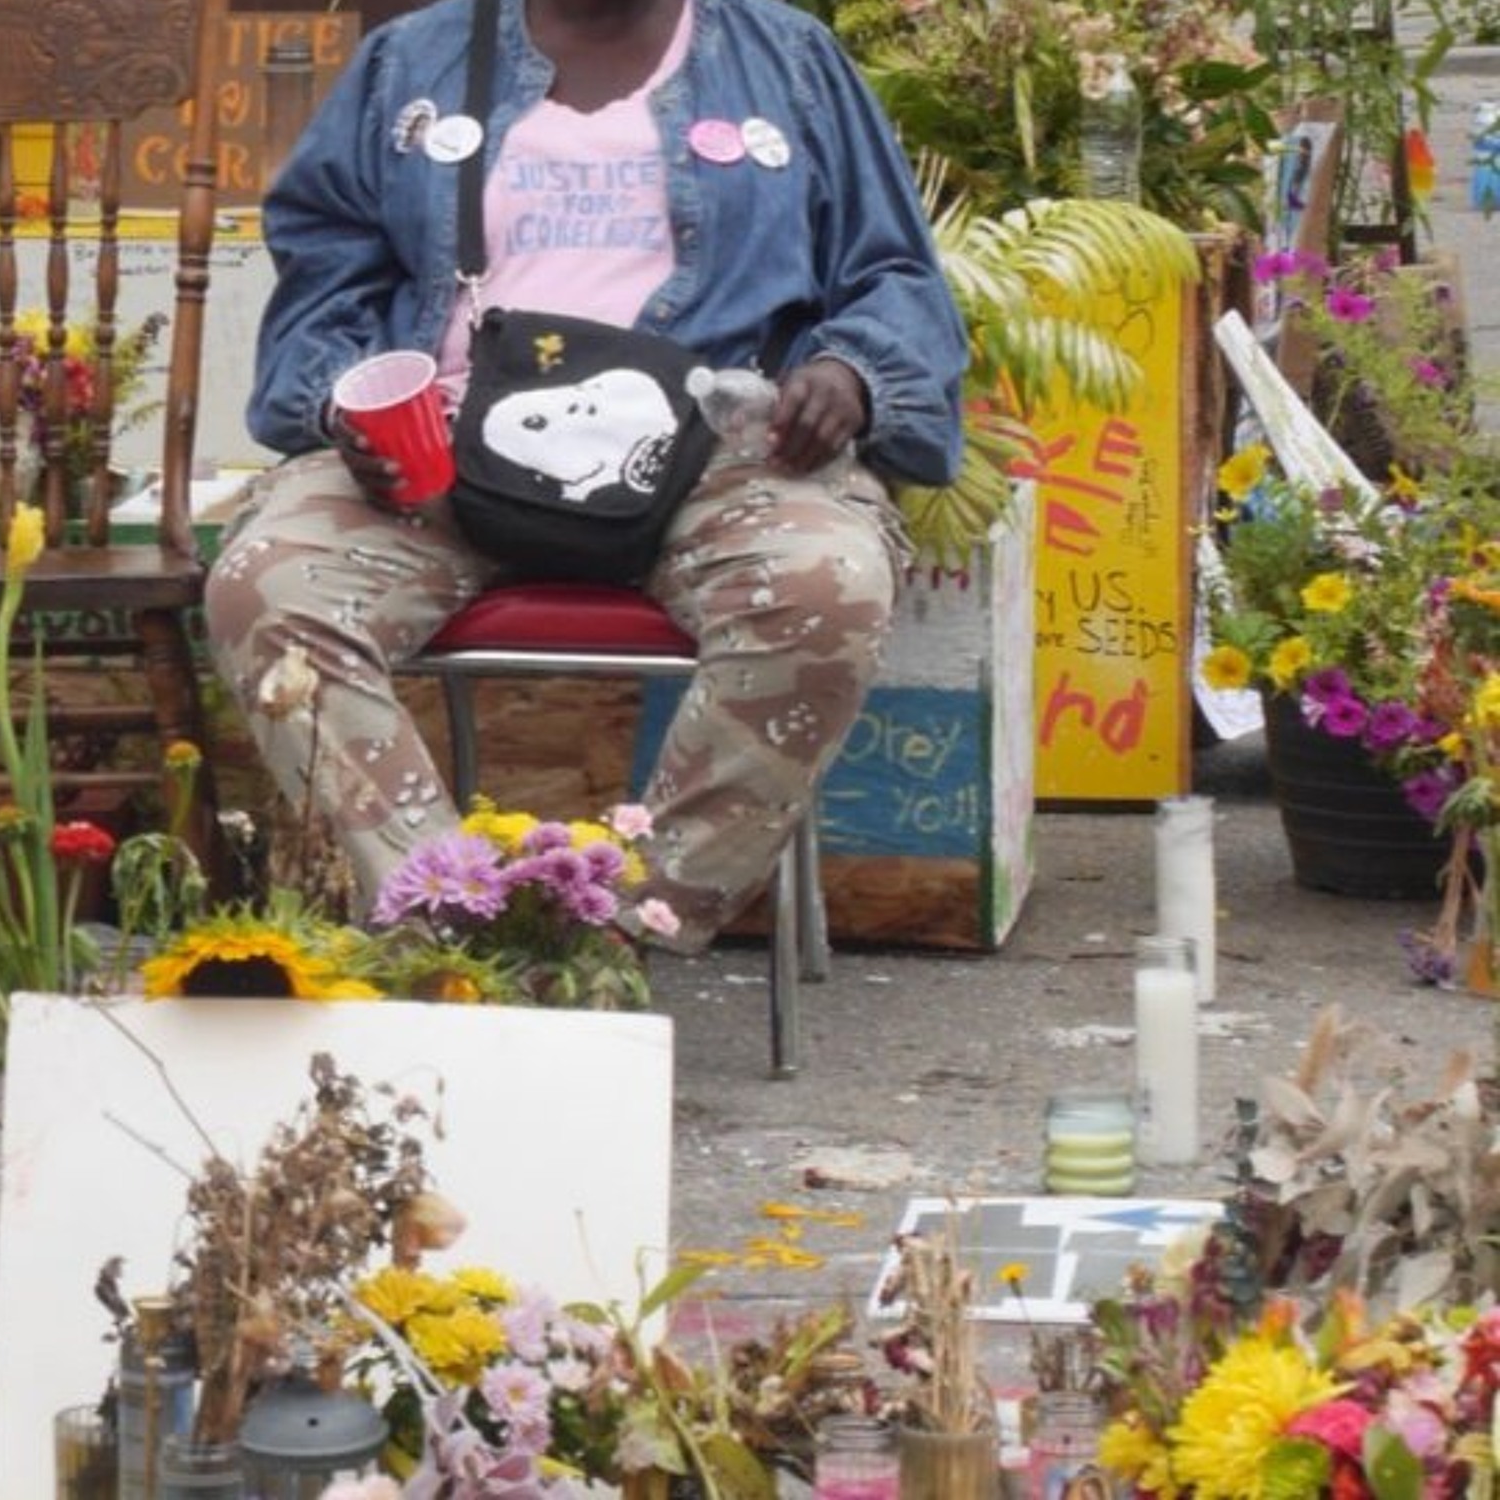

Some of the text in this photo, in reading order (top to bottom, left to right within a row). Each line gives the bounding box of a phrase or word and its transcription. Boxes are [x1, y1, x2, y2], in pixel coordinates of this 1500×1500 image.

[226, 18, 344, 68] TICE
[510, 159, 658, 192] JUSTICE
[1076, 616, 1177, 660] SEEDS
